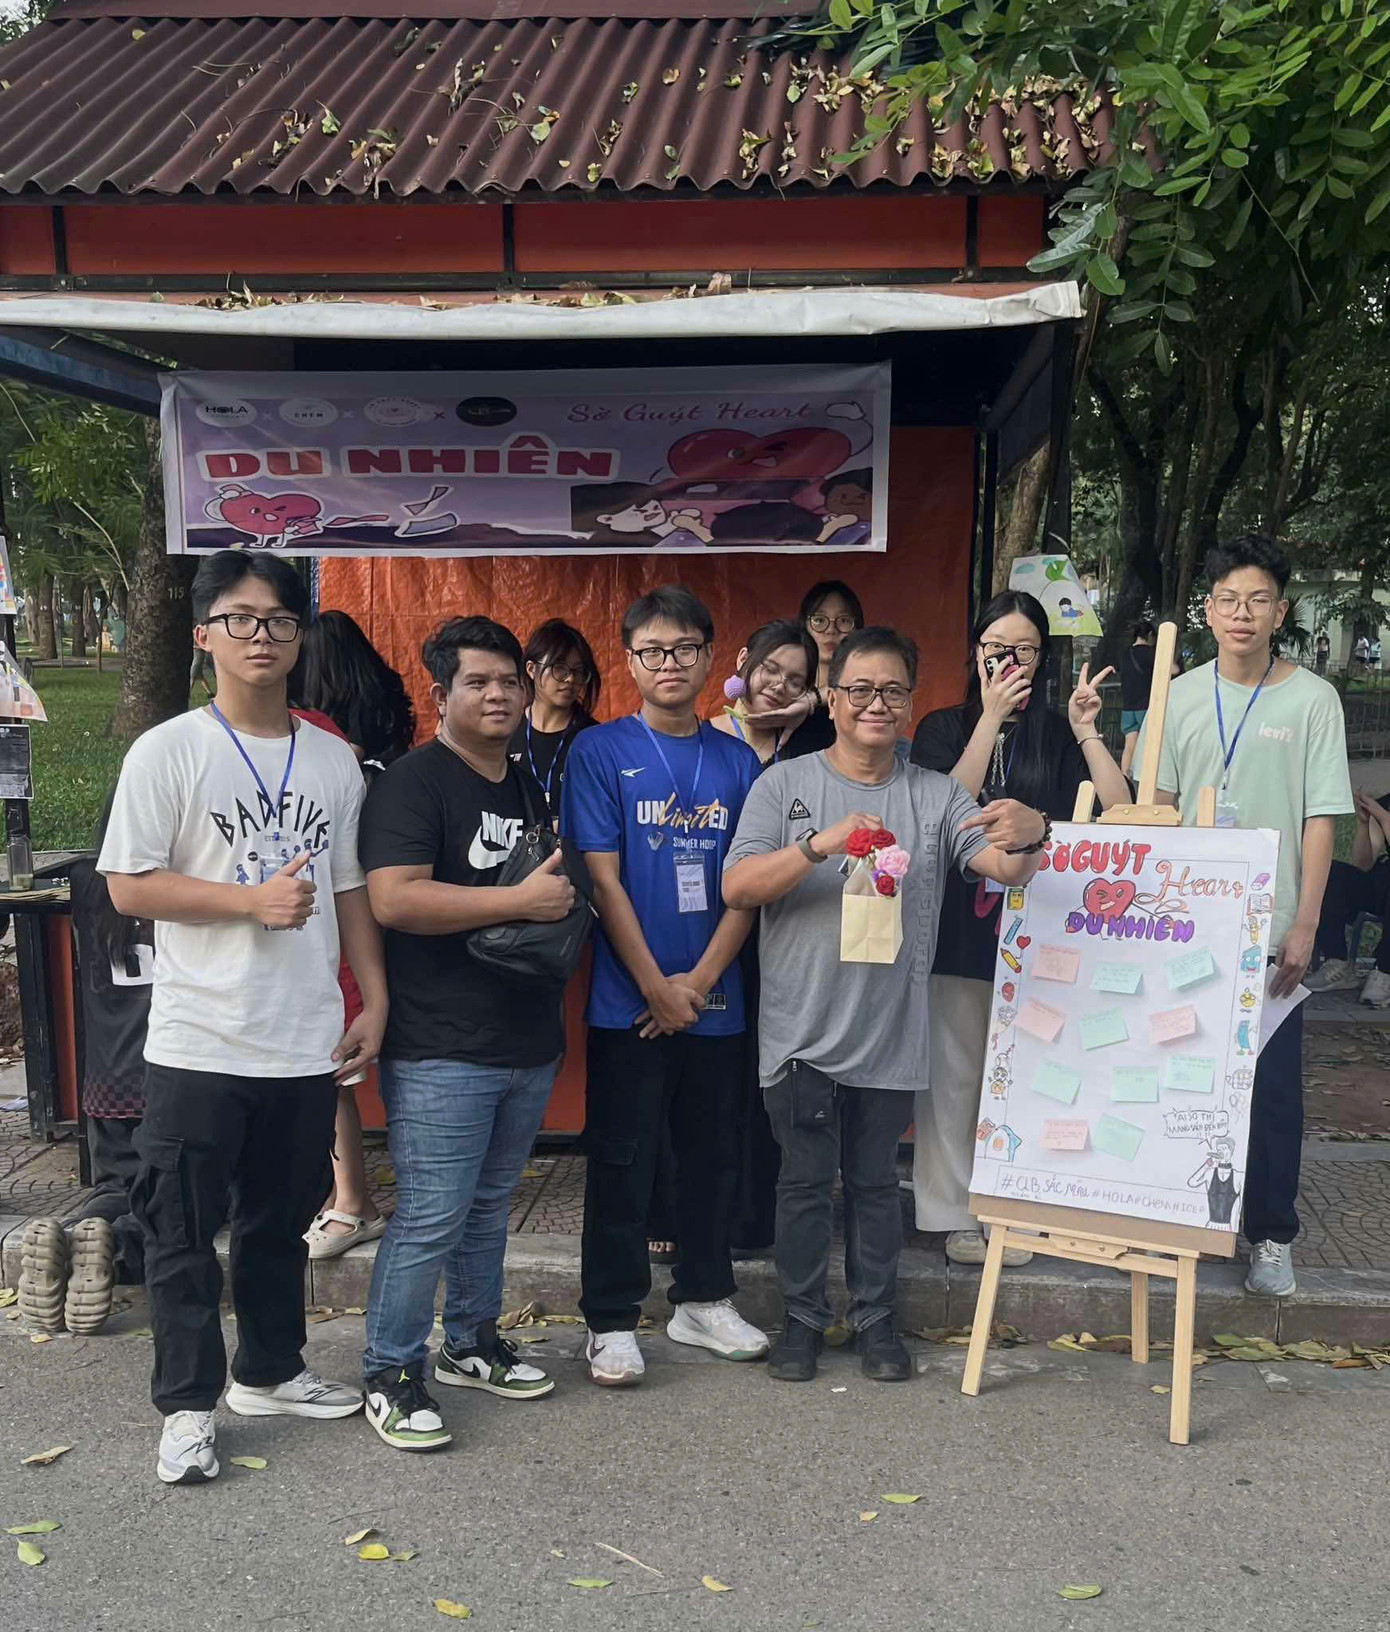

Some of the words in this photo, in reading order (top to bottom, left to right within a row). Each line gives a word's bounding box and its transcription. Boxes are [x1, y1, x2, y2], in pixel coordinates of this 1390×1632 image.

[622, 401, 702, 426] Guýt
[717, 400, 813, 421] Heart
[204, 451, 324, 478] DU
[346, 434, 613, 477] NHIÊN
[209, 789, 331, 849] BADFIVE
